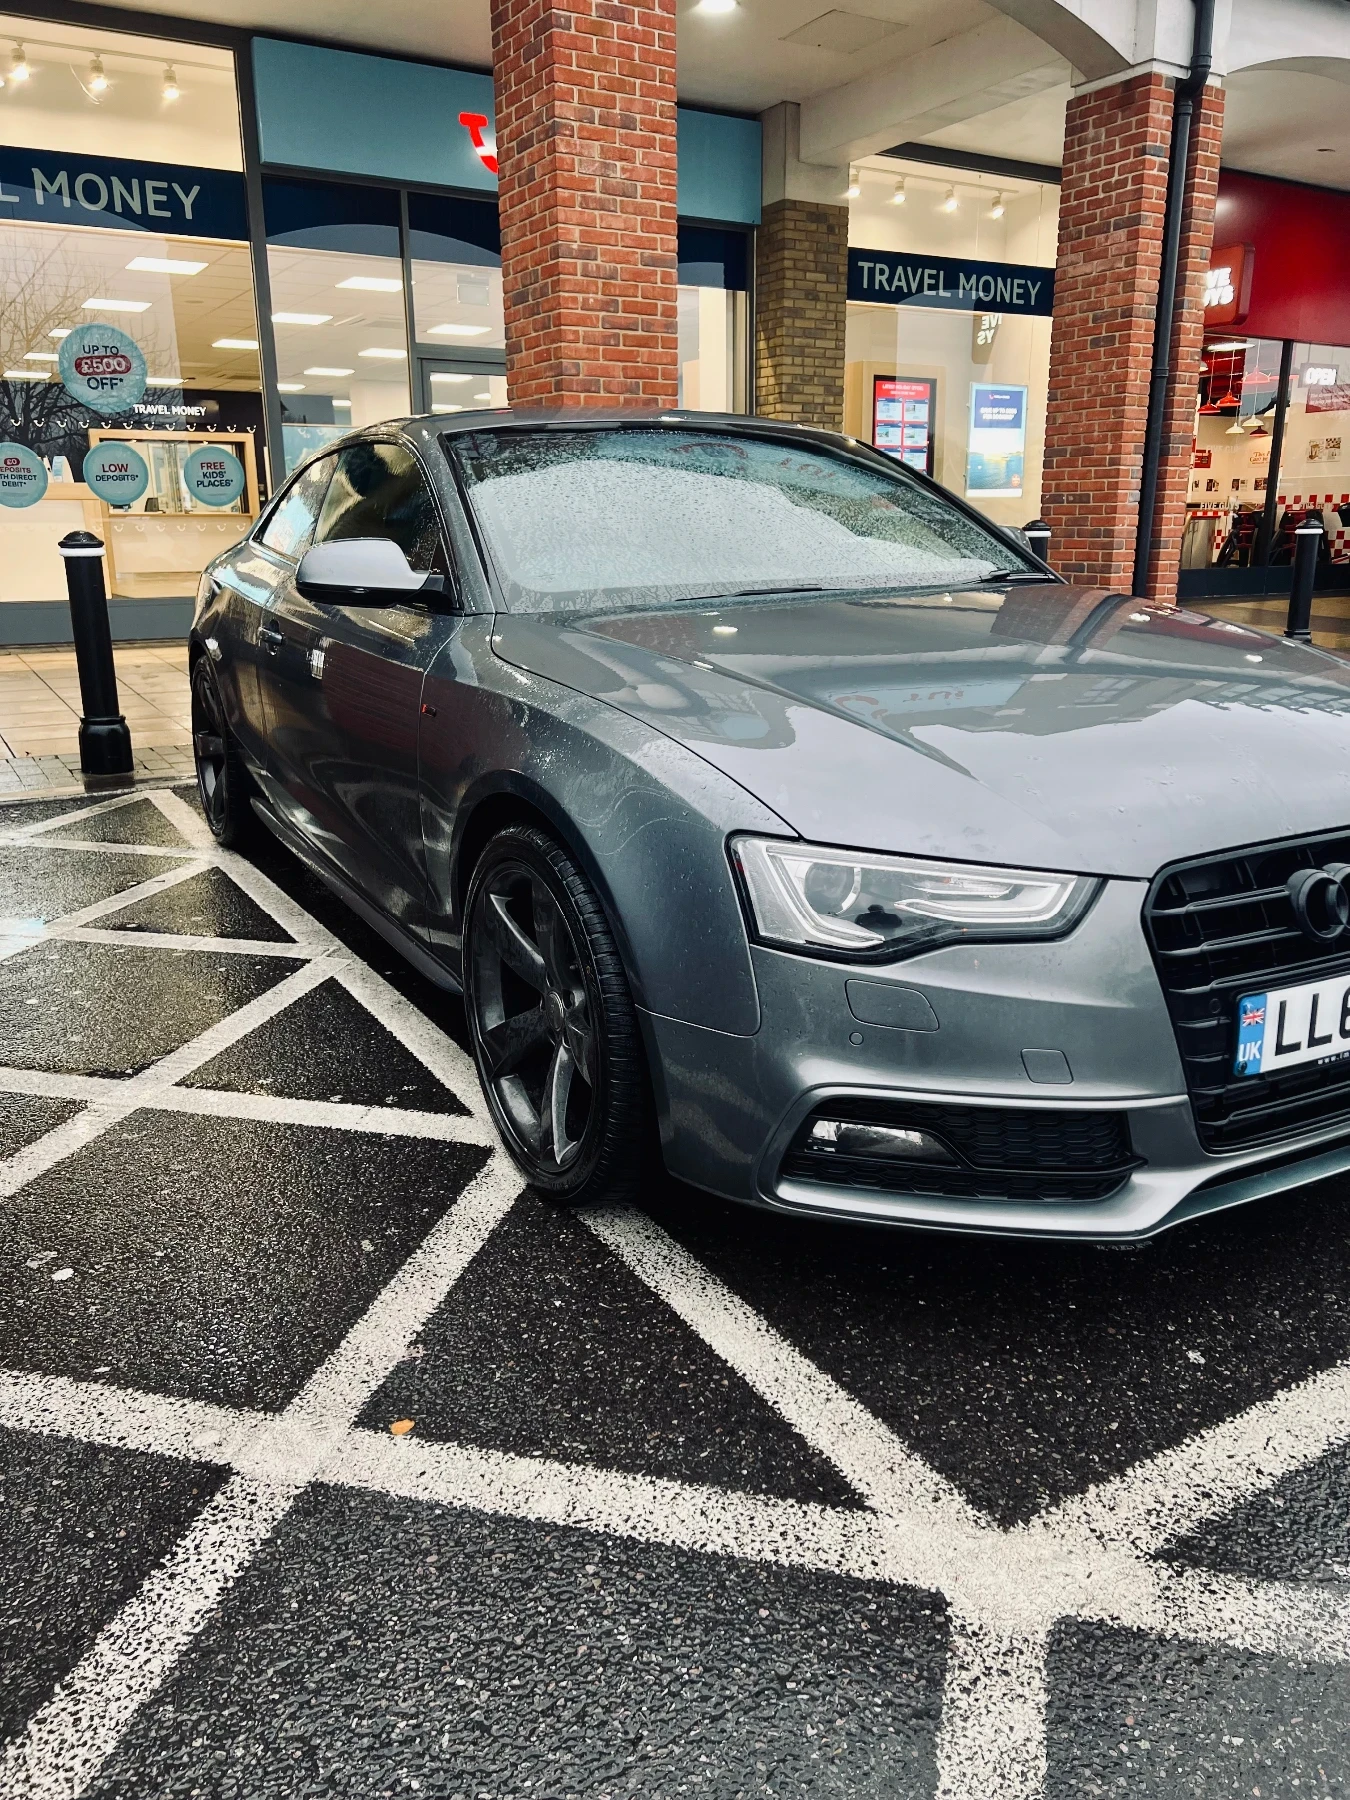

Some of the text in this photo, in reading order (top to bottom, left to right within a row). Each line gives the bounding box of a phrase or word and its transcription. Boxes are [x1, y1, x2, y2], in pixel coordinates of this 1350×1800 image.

[31, 167, 201, 220] MONEY
[858, 261, 1042, 306] TRAVEL MONEY
[1206, 267, 1232, 289] VE
[82, 344, 119, 356] UP TO
[81, 358, 126, 373] £500
[1304, 367, 1337, 386] OPEN
[132, 404, 207, 416] TRAVEL MONEY
[102, 463, 129, 473] LOW
[200, 462, 226, 471] FREE
[1239, 1040, 1262, 1060] UK
